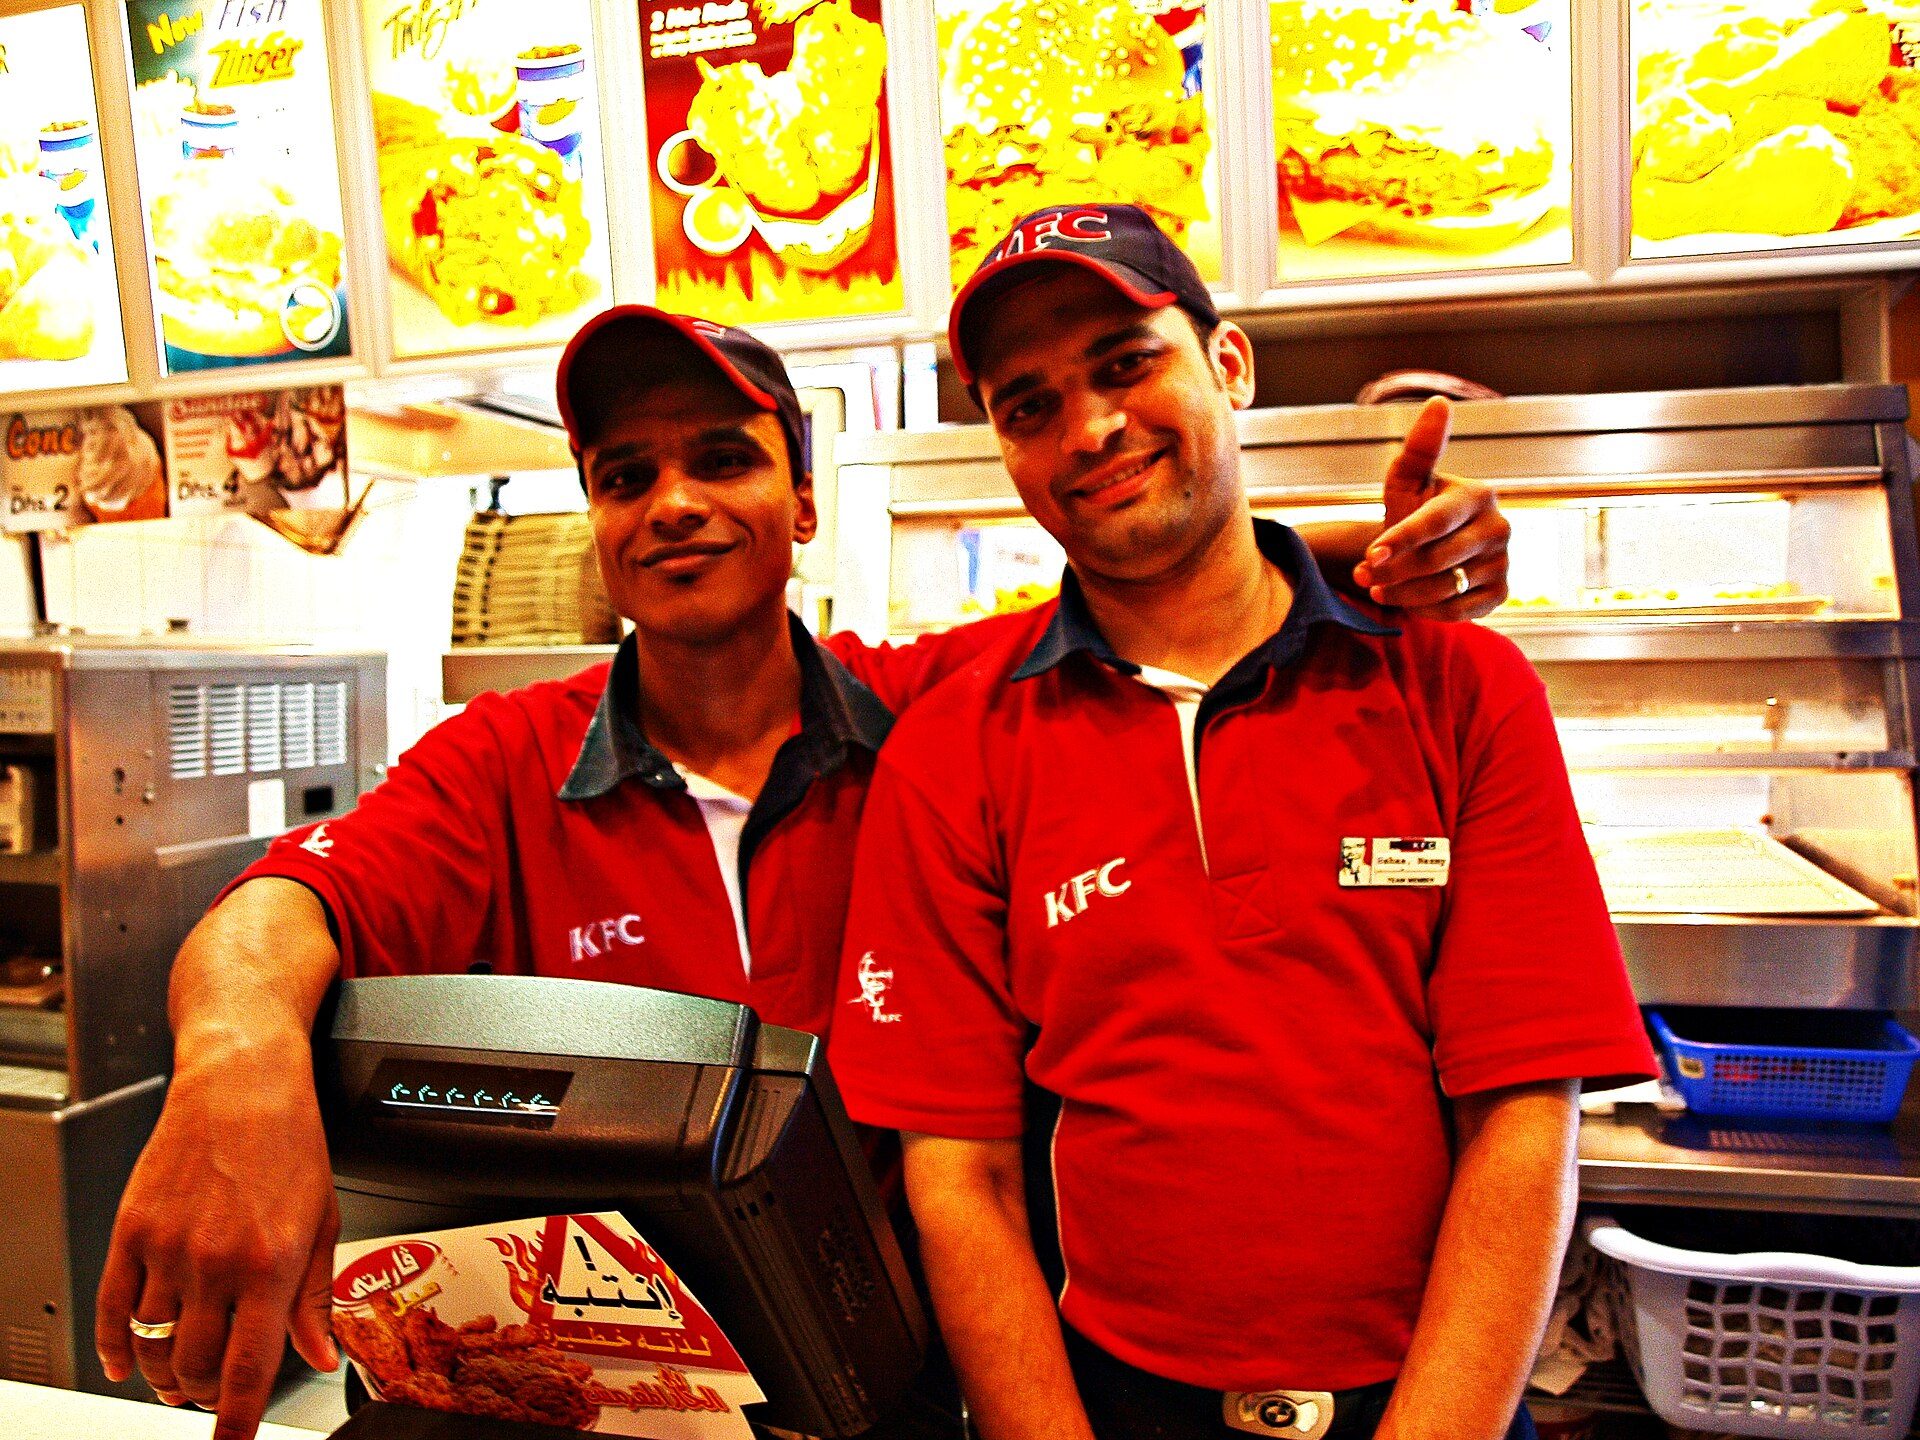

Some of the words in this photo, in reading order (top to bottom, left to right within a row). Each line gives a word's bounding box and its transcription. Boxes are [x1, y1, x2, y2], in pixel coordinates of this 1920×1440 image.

[650, 10, 665, 31] 2
[208, 31, 303, 89] Zinger
[7, 413, 84, 460] Cone
[53, 483, 69, 511] 2
[223, 469, 239, 494] 4
[1043, 857, 1132, 929] KFC
[569, 913, 646, 962] KFC
